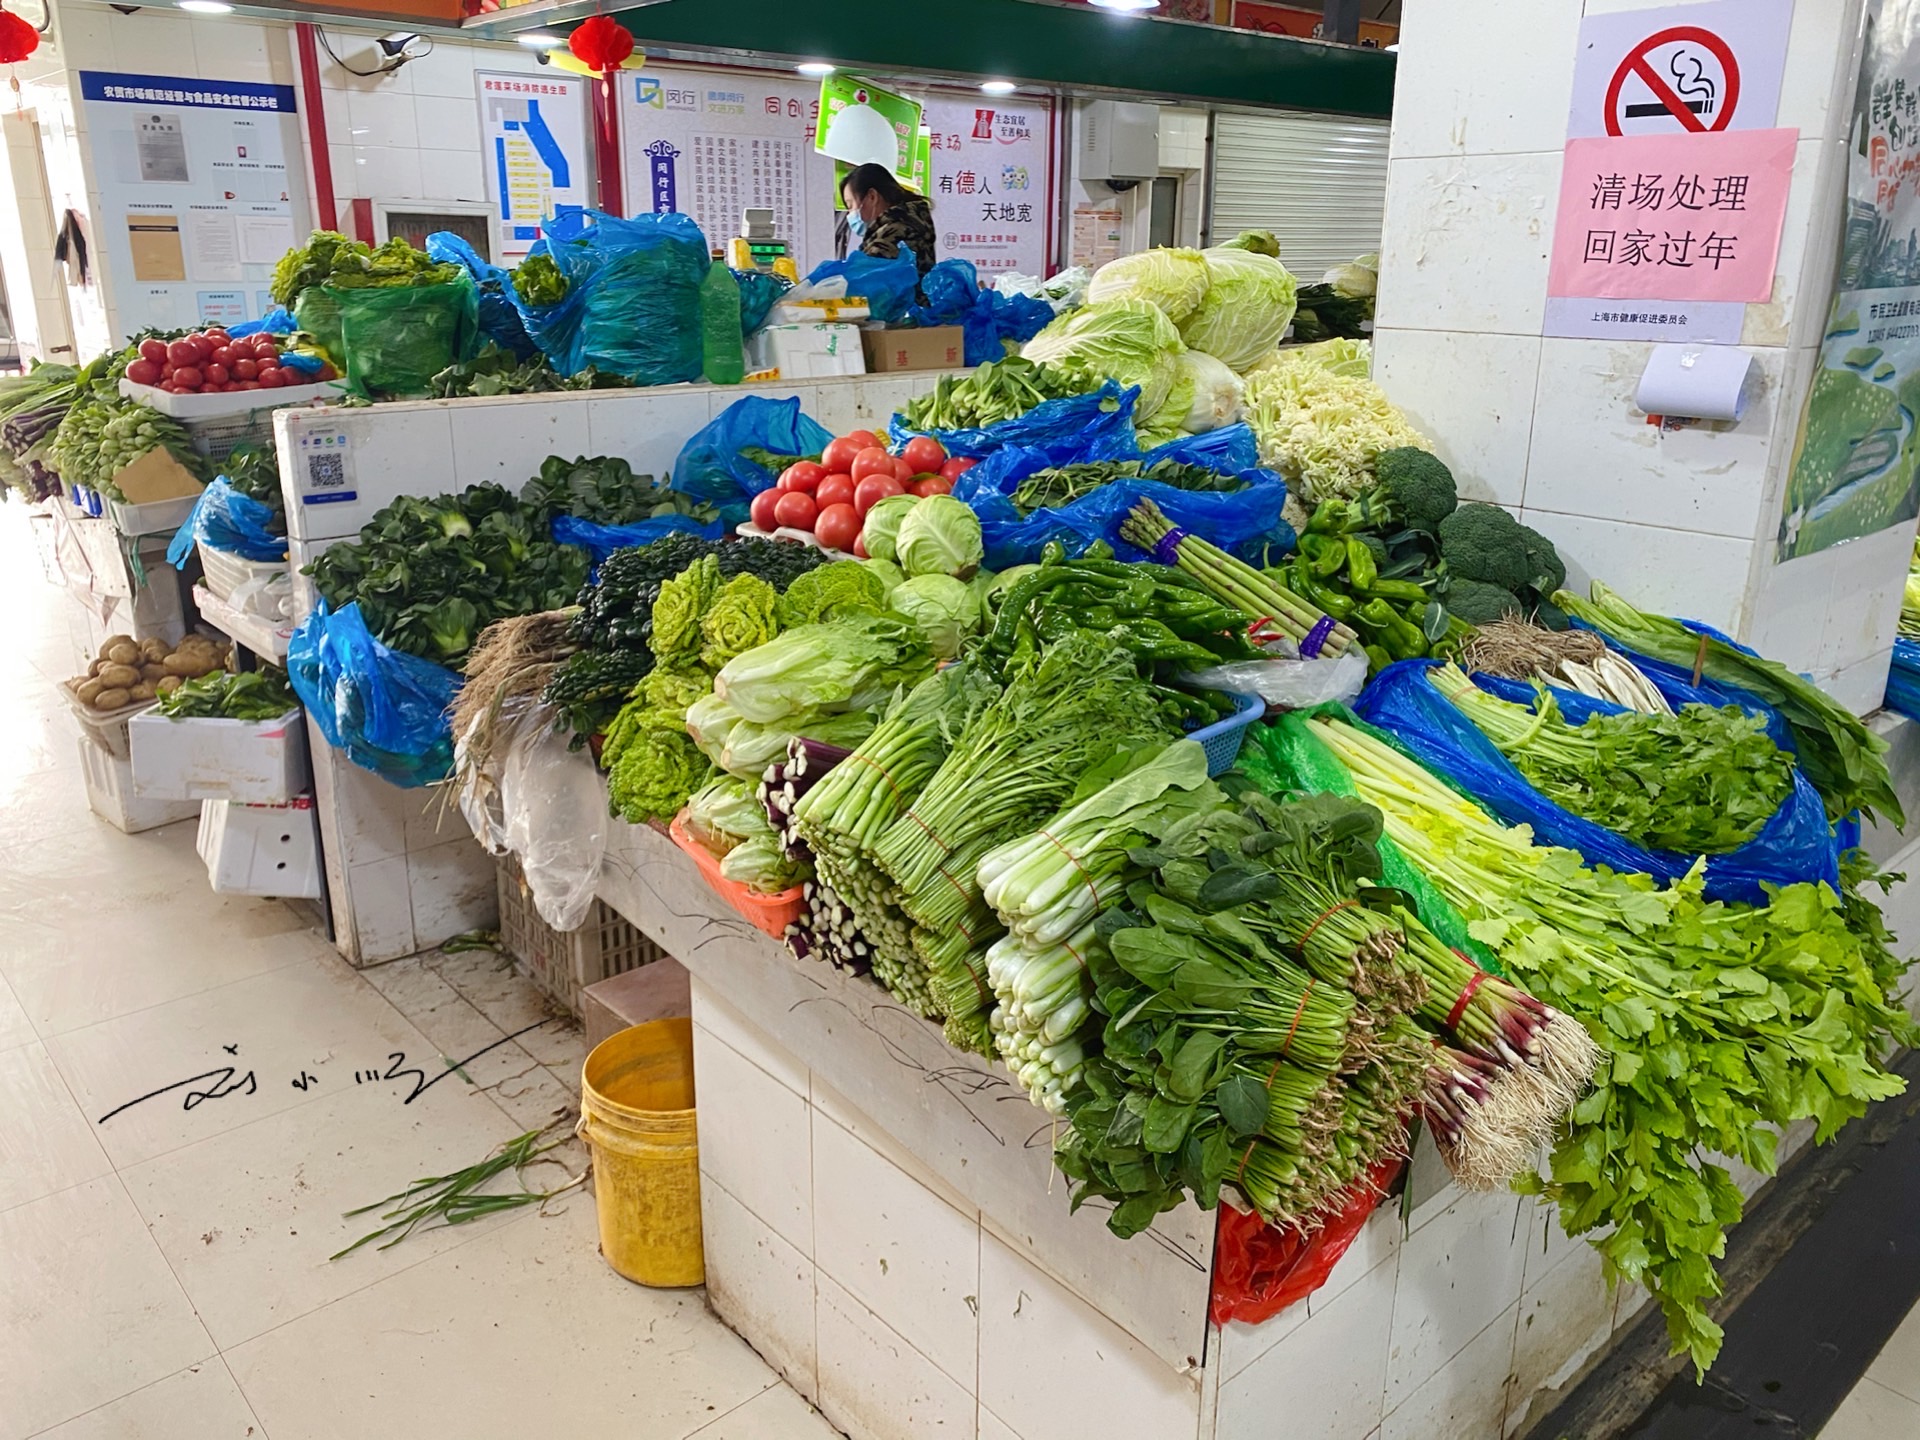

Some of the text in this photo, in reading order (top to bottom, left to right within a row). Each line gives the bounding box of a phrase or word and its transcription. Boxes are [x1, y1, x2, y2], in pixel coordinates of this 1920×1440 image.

[667, 89, 696, 105] 闵行
[994, 113, 1026, 127] 生态宜居
[938, 170, 993, 195] 有德人
[1589, 172, 1750, 212] 清场处理
[981, 202, 1033, 223] 天地宽
[1583, 228, 1738, 271] 回家过年
[1591, 311, 1688, 326] 上海市健康促进委员会
